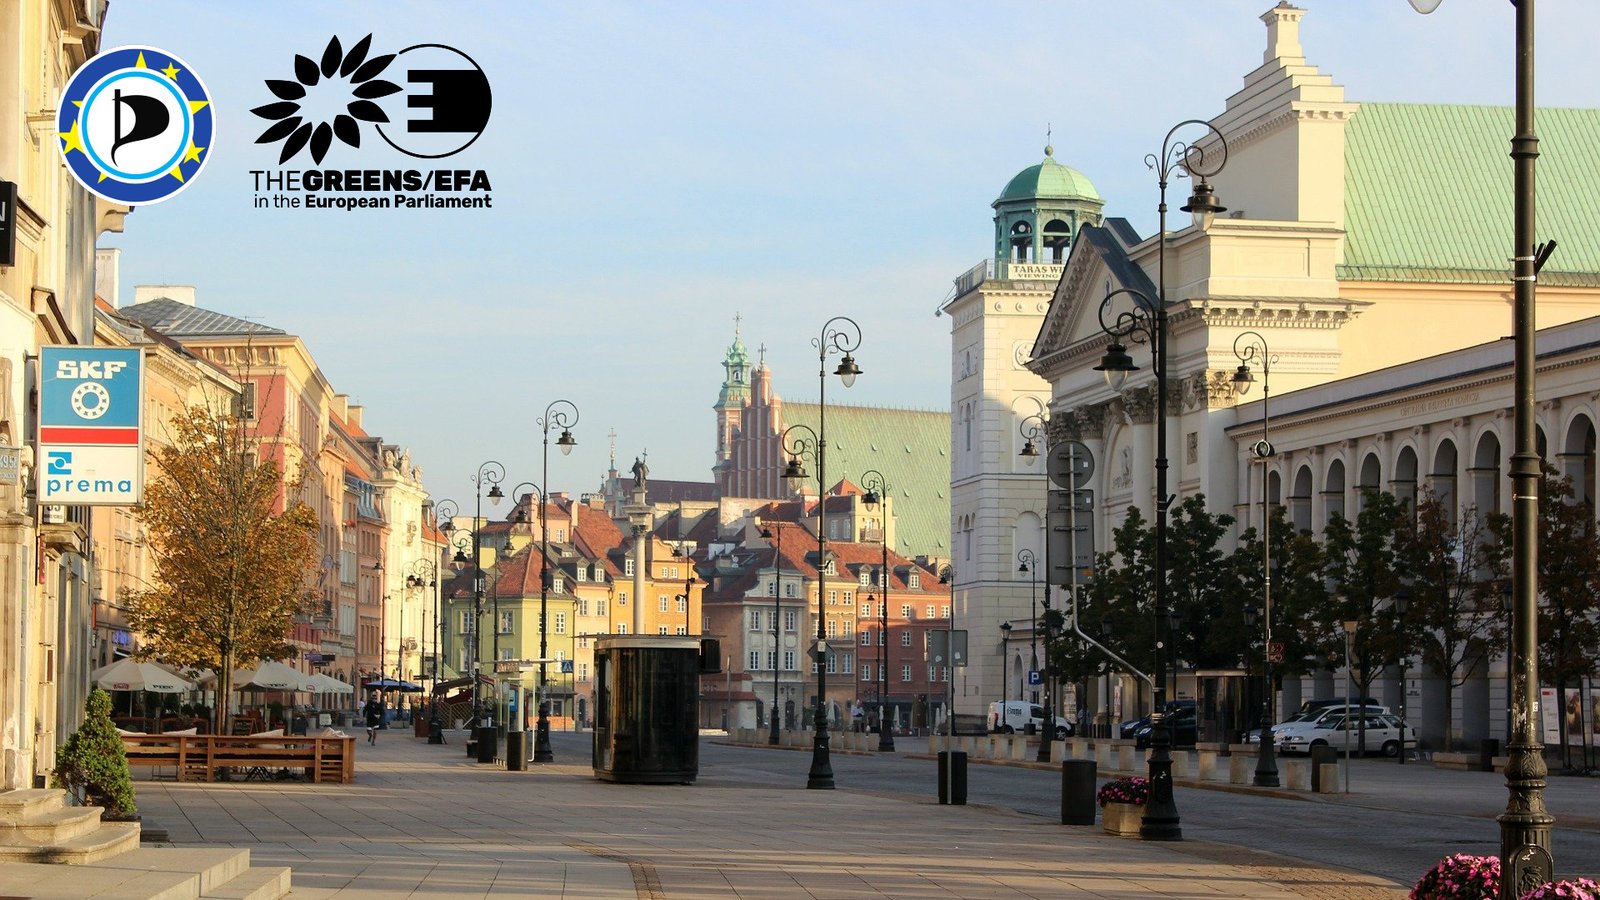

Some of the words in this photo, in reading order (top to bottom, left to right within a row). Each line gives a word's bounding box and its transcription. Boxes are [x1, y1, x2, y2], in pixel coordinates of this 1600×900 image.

[1013, 265, 1048, 273] TARAS
[56, 361, 127, 379] SKF
[47, 478, 131, 496] prema
[1031, 672, 1040, 683] P
